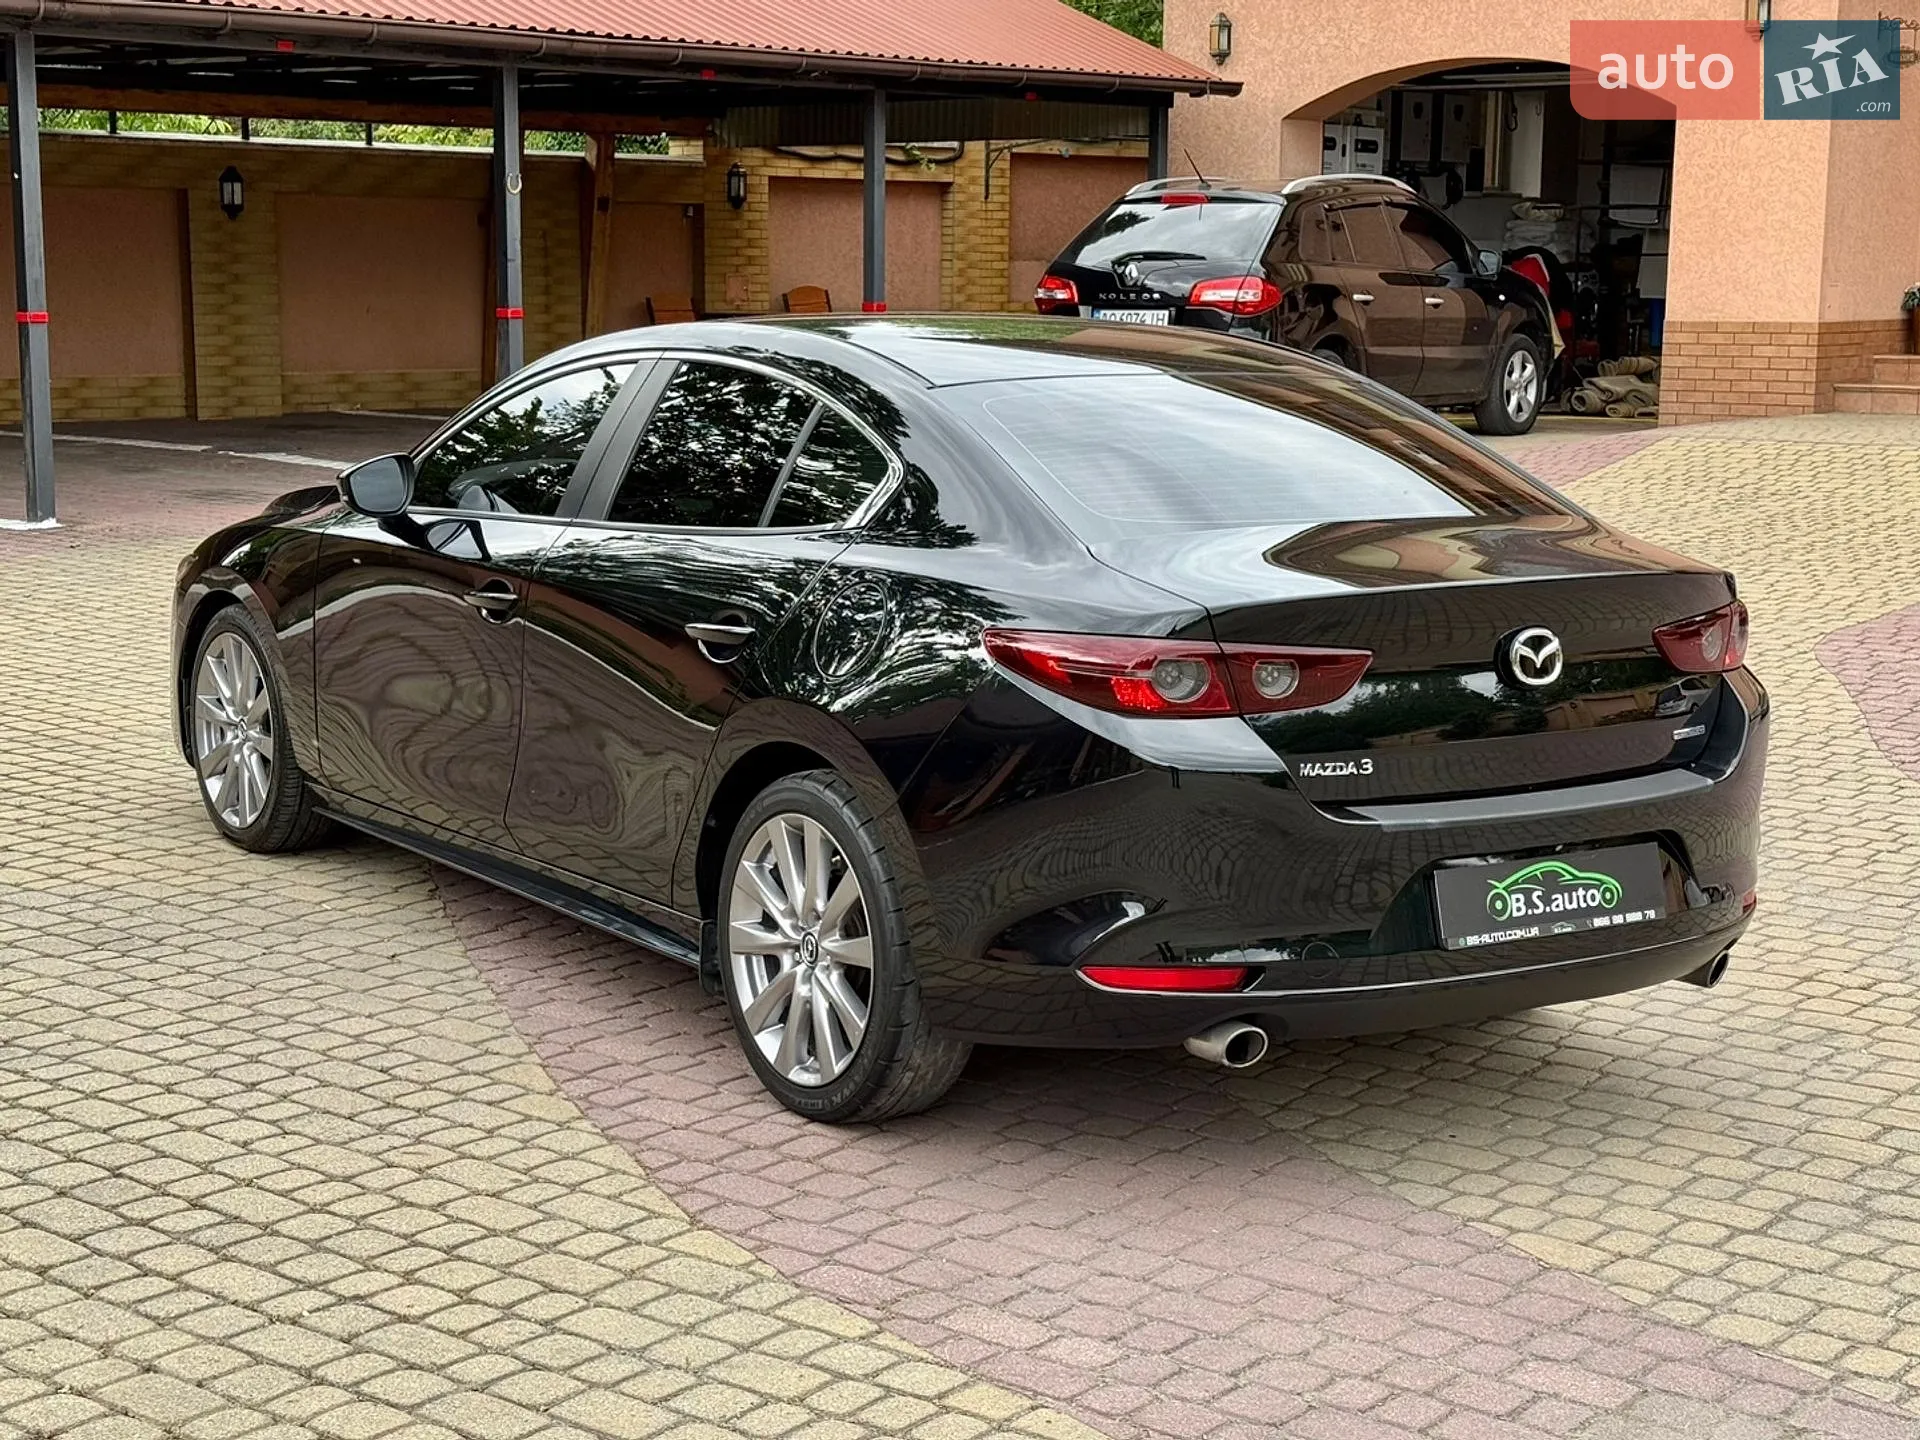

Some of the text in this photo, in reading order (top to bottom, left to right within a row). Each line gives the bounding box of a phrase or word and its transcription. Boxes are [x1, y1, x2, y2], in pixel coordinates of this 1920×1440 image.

[1300, 758, 1374, 776] MAZDA 3
[1511, 888, 1600, 917] B.S.auto
[1466, 927, 1539, 946] BS-AUTO.COM.UA
